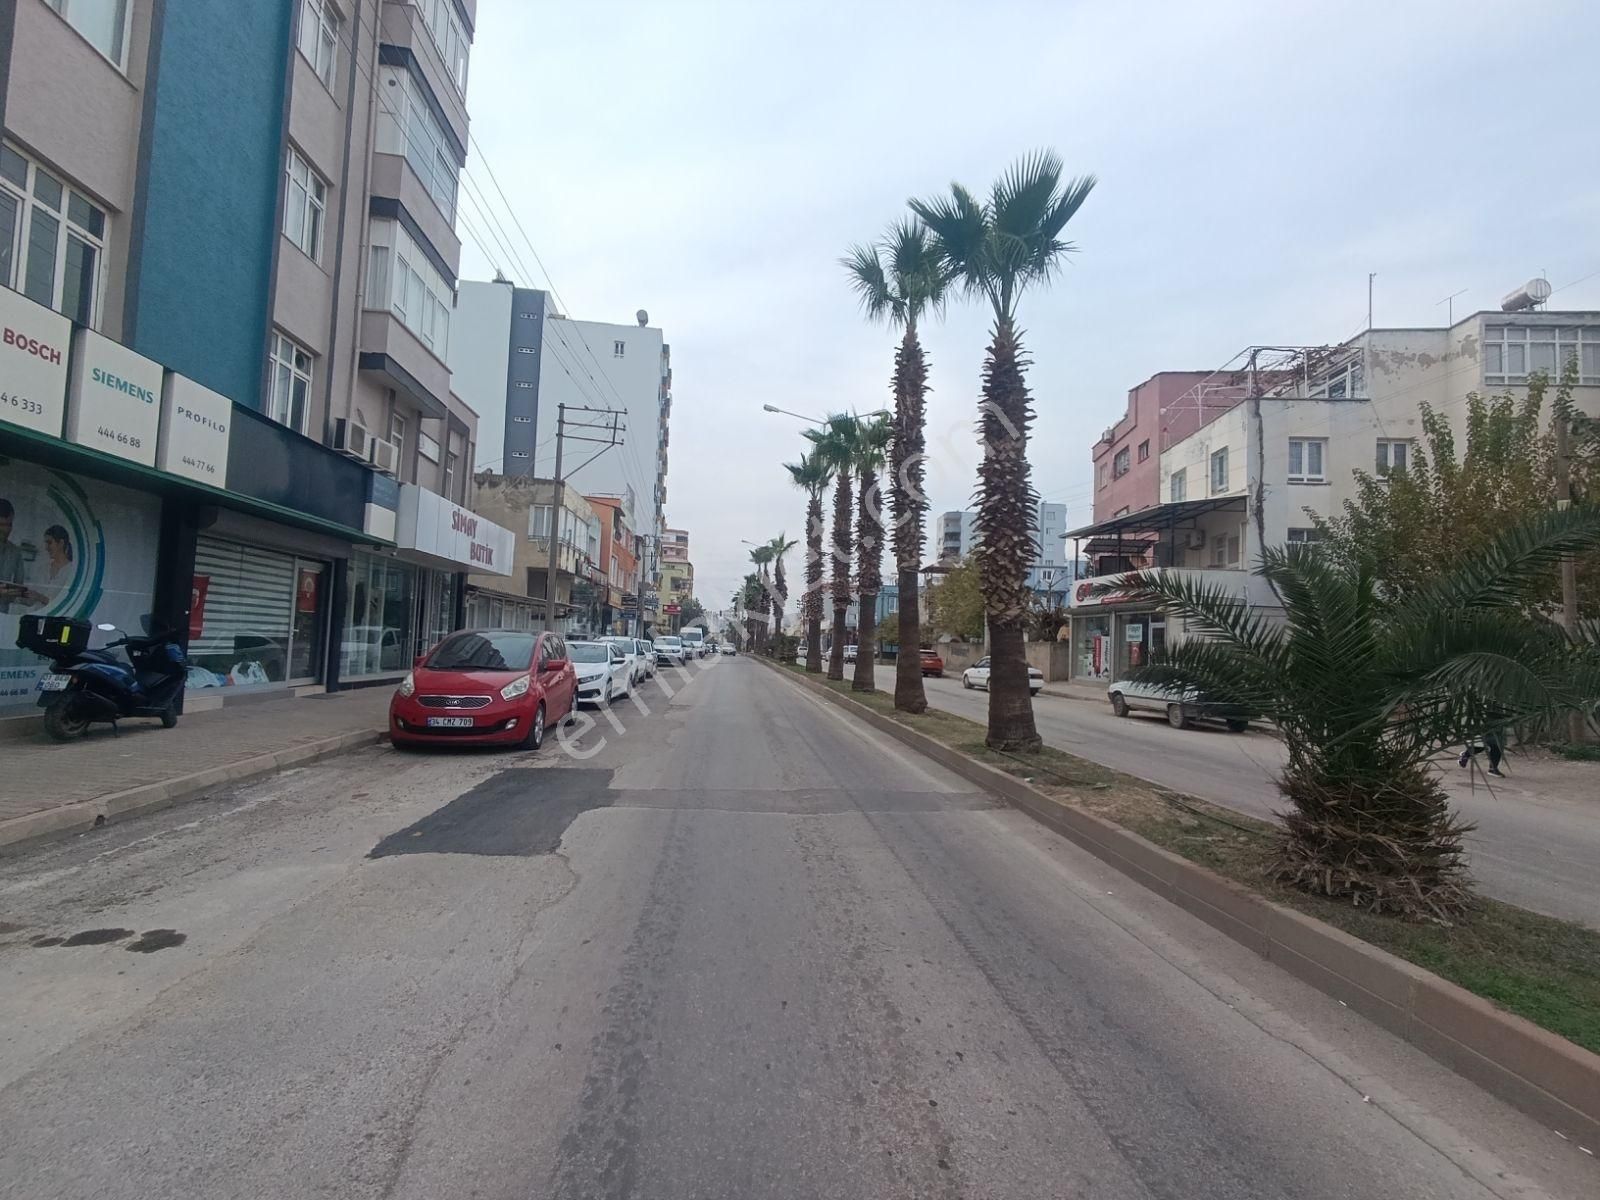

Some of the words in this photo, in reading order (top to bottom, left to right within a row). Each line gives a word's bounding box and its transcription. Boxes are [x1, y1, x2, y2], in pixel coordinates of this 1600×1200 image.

[3, 327, 61, 366] BOSCH
[92, 367, 154, 404] SIEMENS
[11, 395, 19, 406] 6
[21, 398, 42, 415] 333
[97, 424, 115, 440] 444
[117, 433, 128, 444] 66
[130, 436, 141, 448] 88
[182, 455, 195, 467] 444
[197, 459, 205, 469] 77
[206, 463, 215, 474] 66
[431, 718, 440, 726] 34
[443, 718, 456, 726] CMZ
[459, 718, 472, 726] 709
